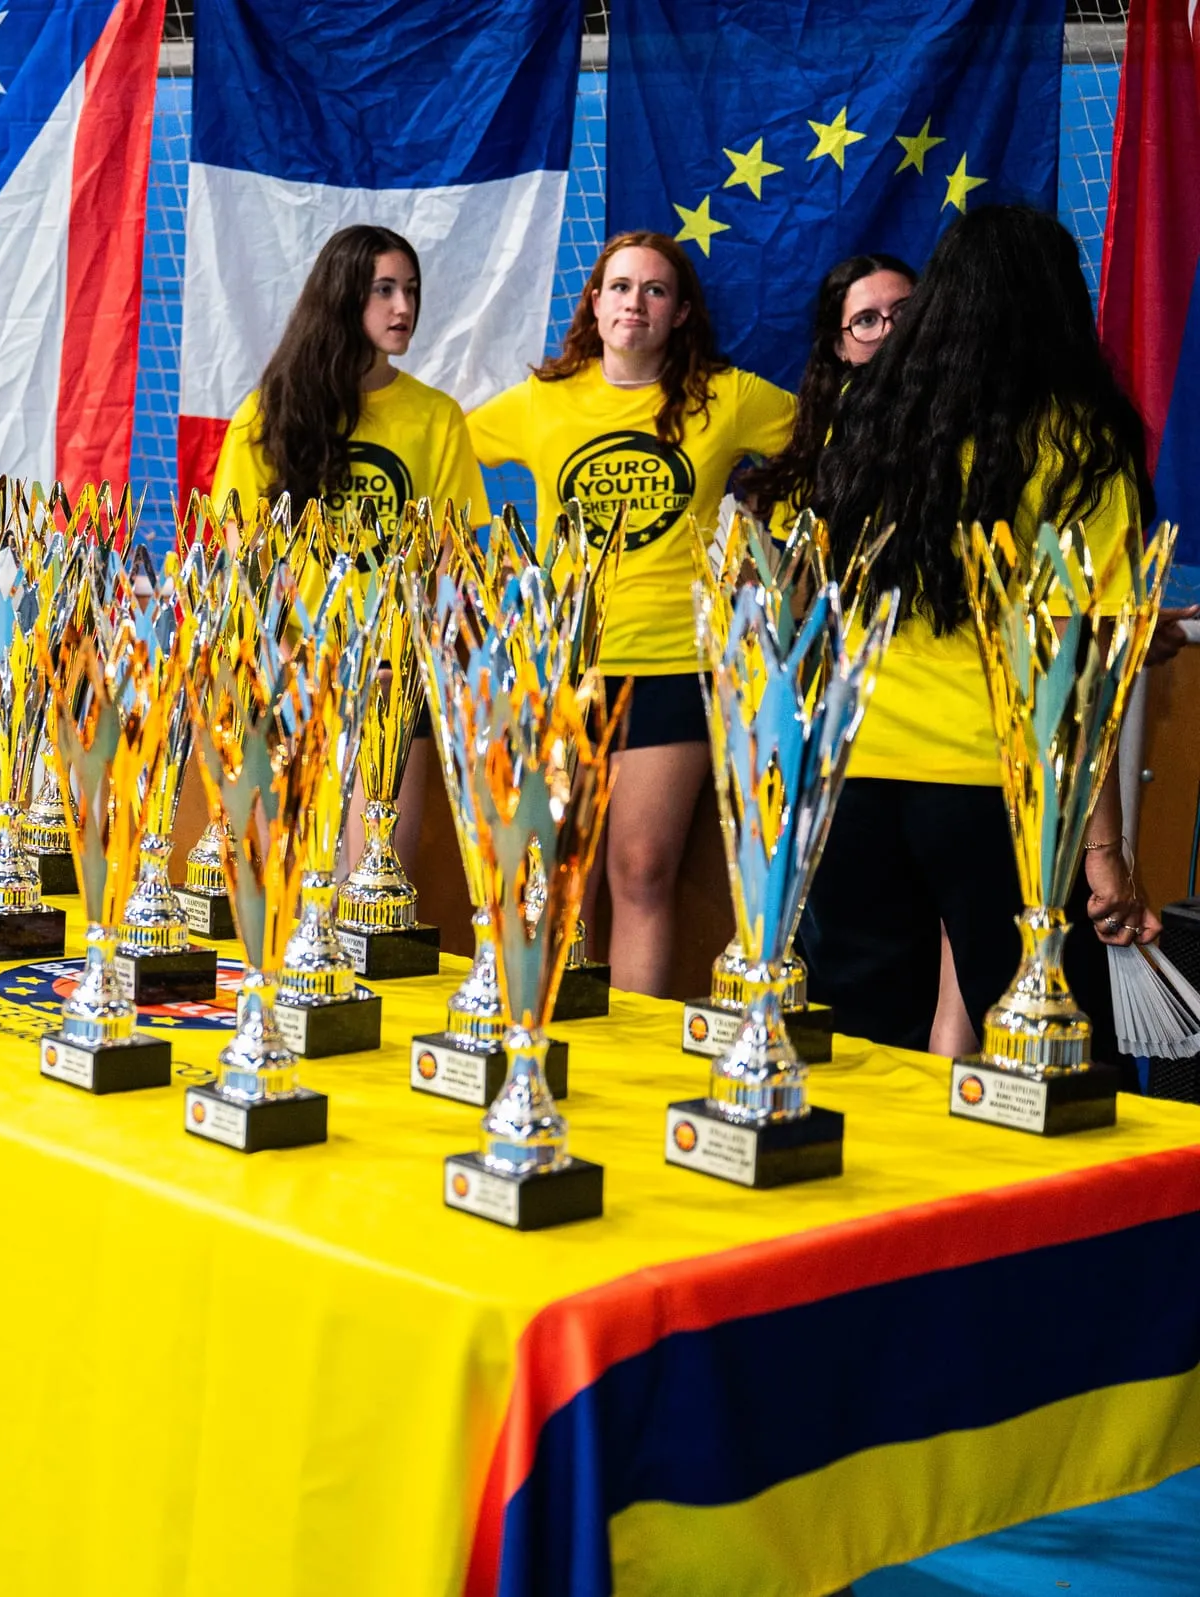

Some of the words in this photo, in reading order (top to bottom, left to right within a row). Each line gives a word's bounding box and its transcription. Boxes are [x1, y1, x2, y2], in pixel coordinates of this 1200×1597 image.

[589, 458, 661, 477] EURO
[339, 475, 388, 492] URO
[578, 475, 669, 497] YOUTH
